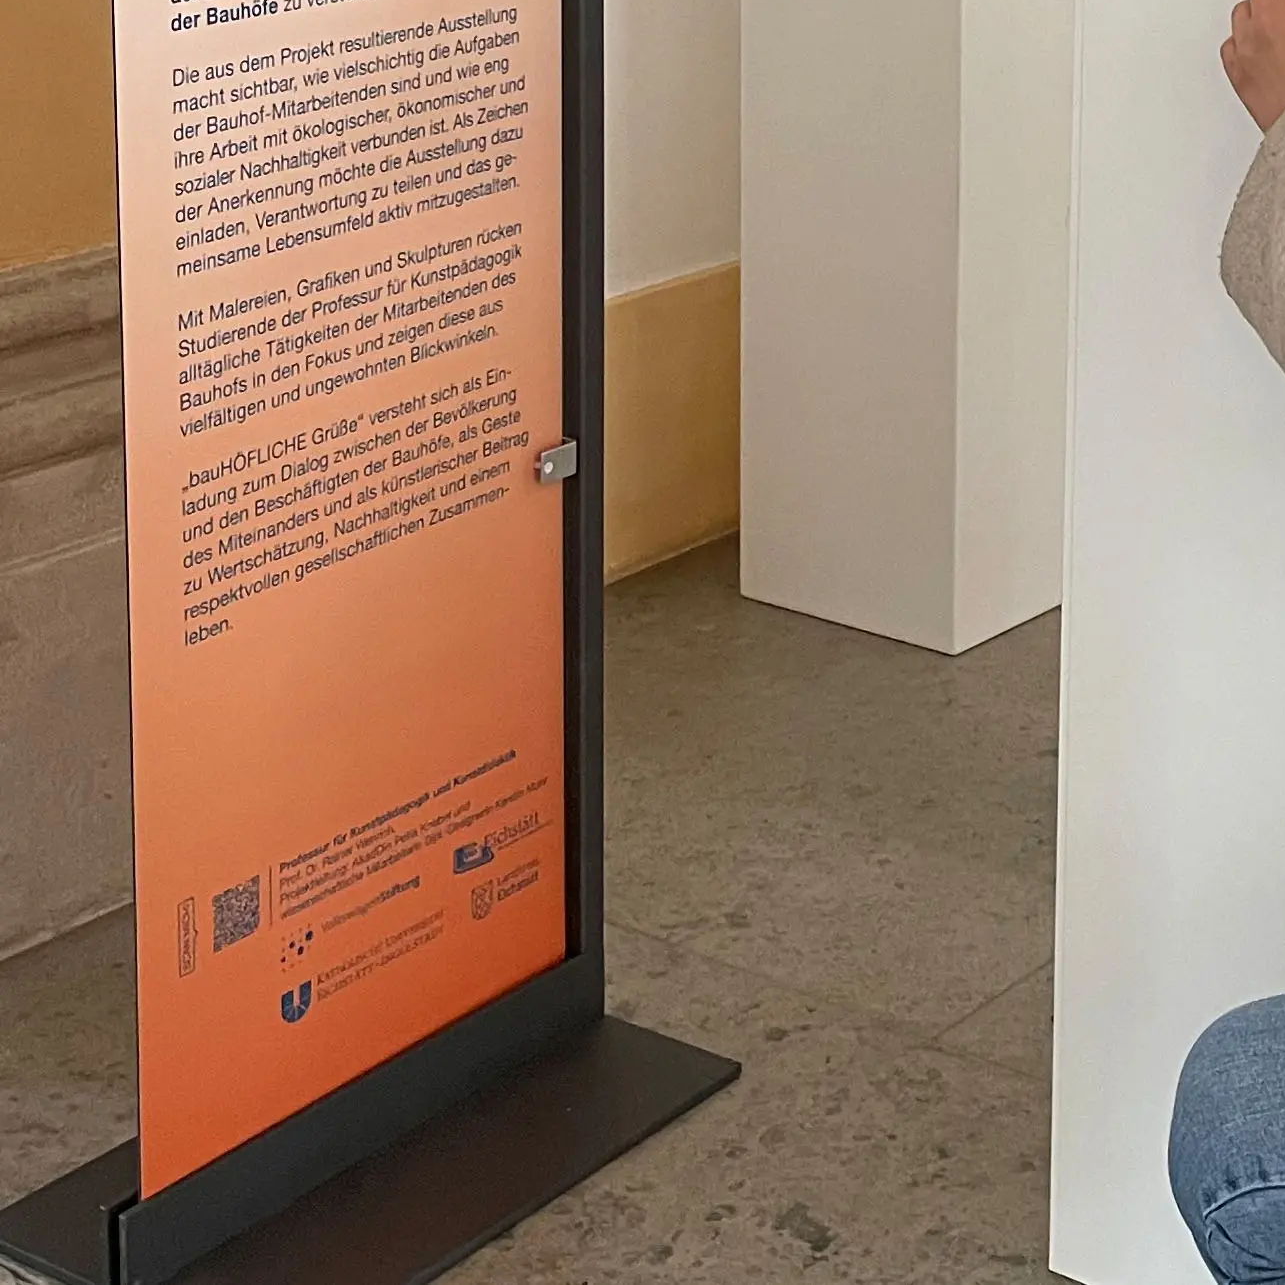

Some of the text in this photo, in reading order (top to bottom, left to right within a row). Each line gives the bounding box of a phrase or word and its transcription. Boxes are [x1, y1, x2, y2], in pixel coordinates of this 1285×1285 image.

[170, 12, 200, 31] der
[172, 8, 516, 86] Die aus dem Projekt resultierende Ausstellung
[172, 31, 519, 114] macht sichtbar, wie vielschichtig die Aufgaben
[173, 58, 508, 141] der Bauhof-Mitarbeitenden sind und wie eng
[174, 150, 204, 168] ihre
[209, 135, 258, 160] Arbeit
[263, 128, 287, 148] mit
[396, 84, 496, 118] ökonomischer
[499, 74, 525, 94] und
[174, 112, 473, 196] sozialer Nachhaltigkeit verbunden ist. Als
[175, 136, 486, 222] der Anerkennung möchte die Ausstellung
[175, 158, 491, 250] einladen, Verantwortung zu teilen und das
[176, 203, 412, 277] meinsame Lebensumfeld aktiv
[178, 236, 472, 331] Mit Malereien, Grafiken und Skulpturen
[178, 278, 406, 357] Studierende der Professur für
[178, 272, 515, 384] alltägliche Tätigkeiten der Mitarbeitenden des
[179, 321, 433, 411] Bauhofs in den Fokus und zeigen
[179, 354, 405, 436] vielfältigen und ungewohnten
[368, 394, 426, 425] versteht
[430, 383, 458, 404] sich
[182, 419, 428, 515] ladung zum Dialog zwischen der
[182, 434, 454, 542] und den Beschäftigten der Bauhöfe,
[182, 485, 377, 568] des Miteinanders und als
[183, 576, 202, 595] zu
[334, 487, 435, 537] Nachhaltigkeit
[184, 569, 289, 620] respektvollen
[184, 618, 233, 645] leben.
